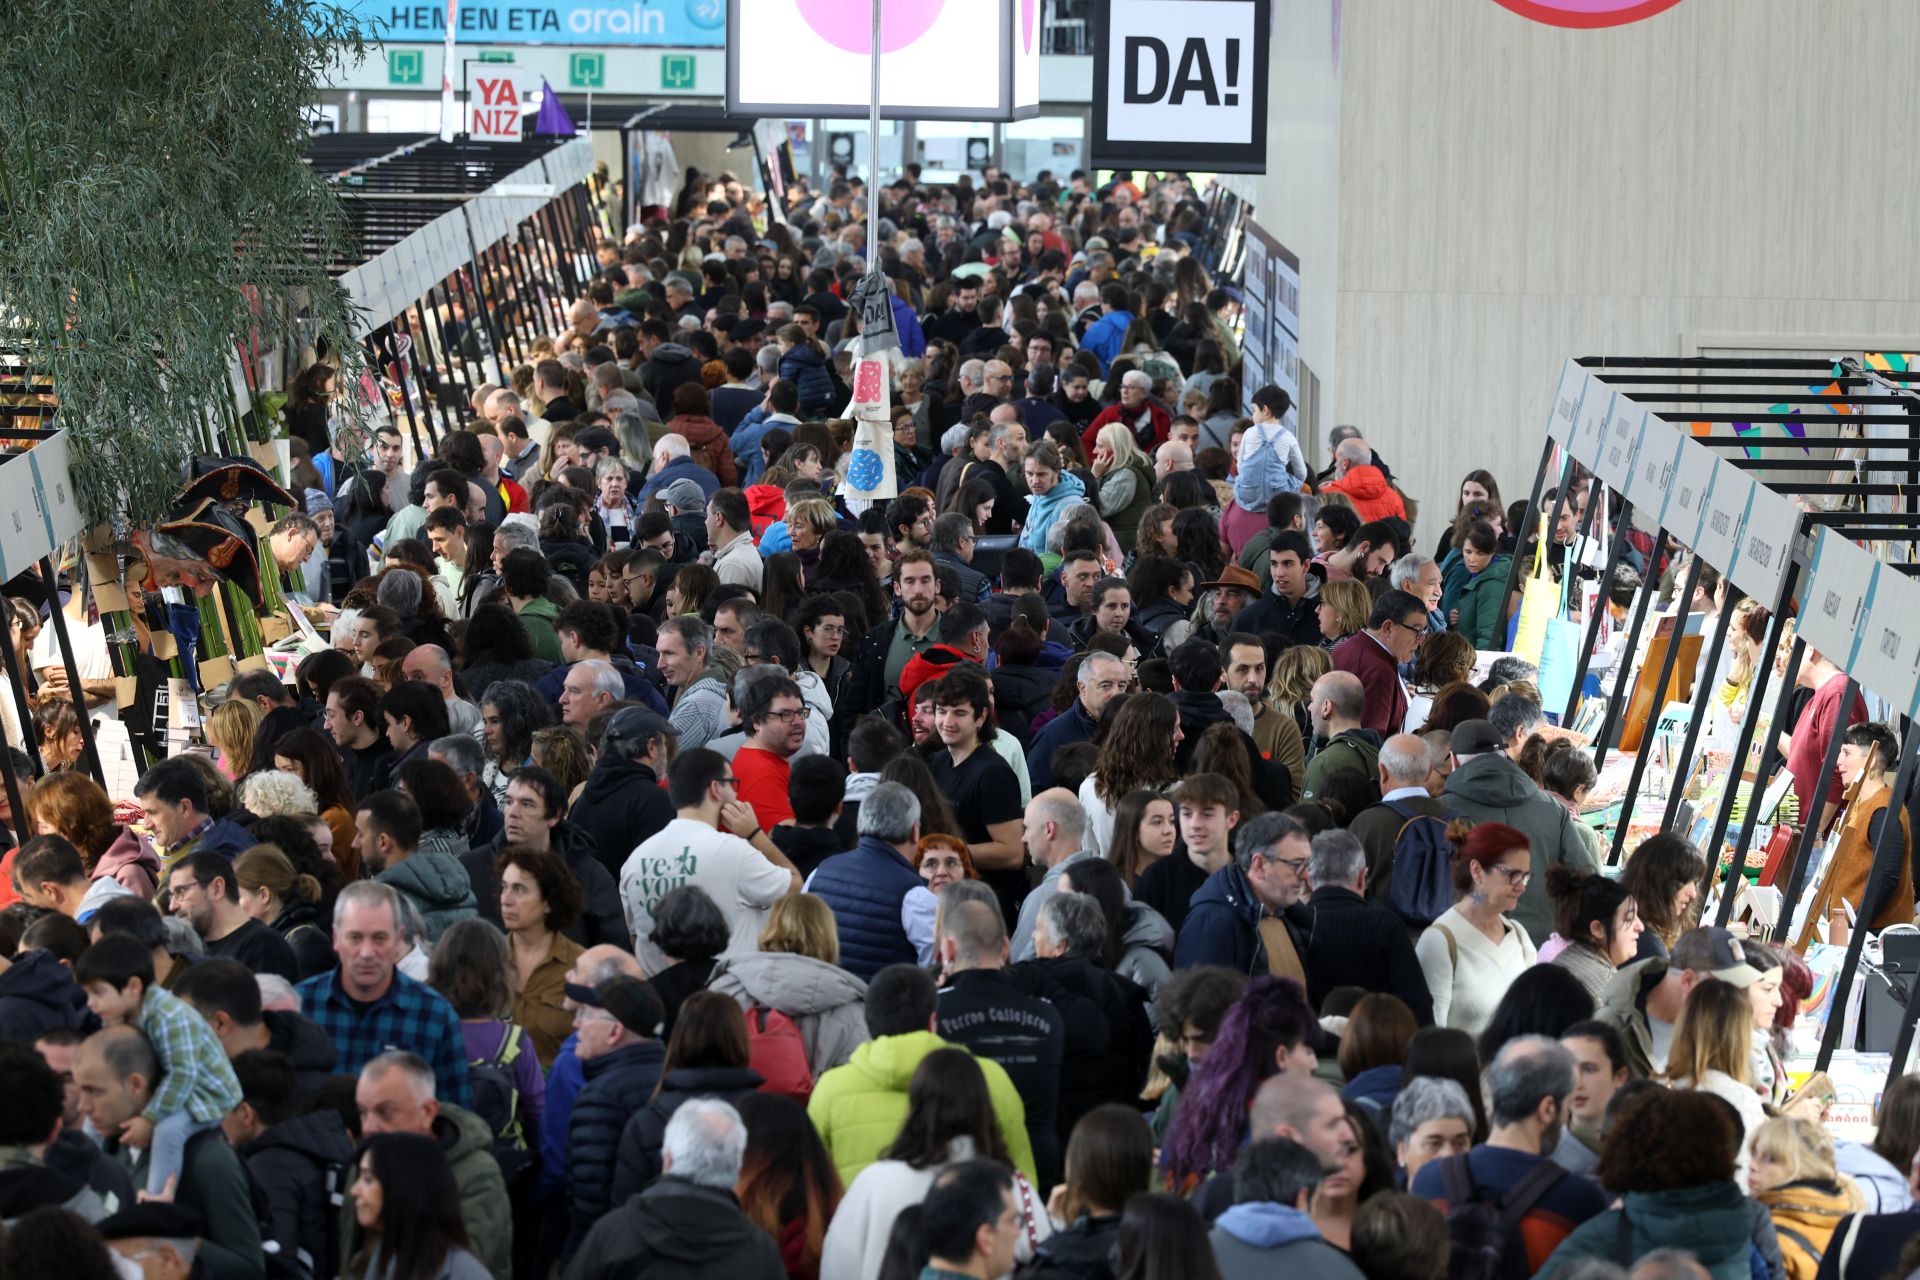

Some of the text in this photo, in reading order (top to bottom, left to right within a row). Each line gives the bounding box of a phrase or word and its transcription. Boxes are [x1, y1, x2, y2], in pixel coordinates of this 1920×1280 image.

[508, 8, 560, 31] ETA
[1124, 36, 1240, 106] DA!
[476, 79, 518, 106] YA
[474, 110, 518, 135] NIZ
[865, 302, 885, 325] DA!
[941, 1007, 1051, 1034] Perros Callejeros
